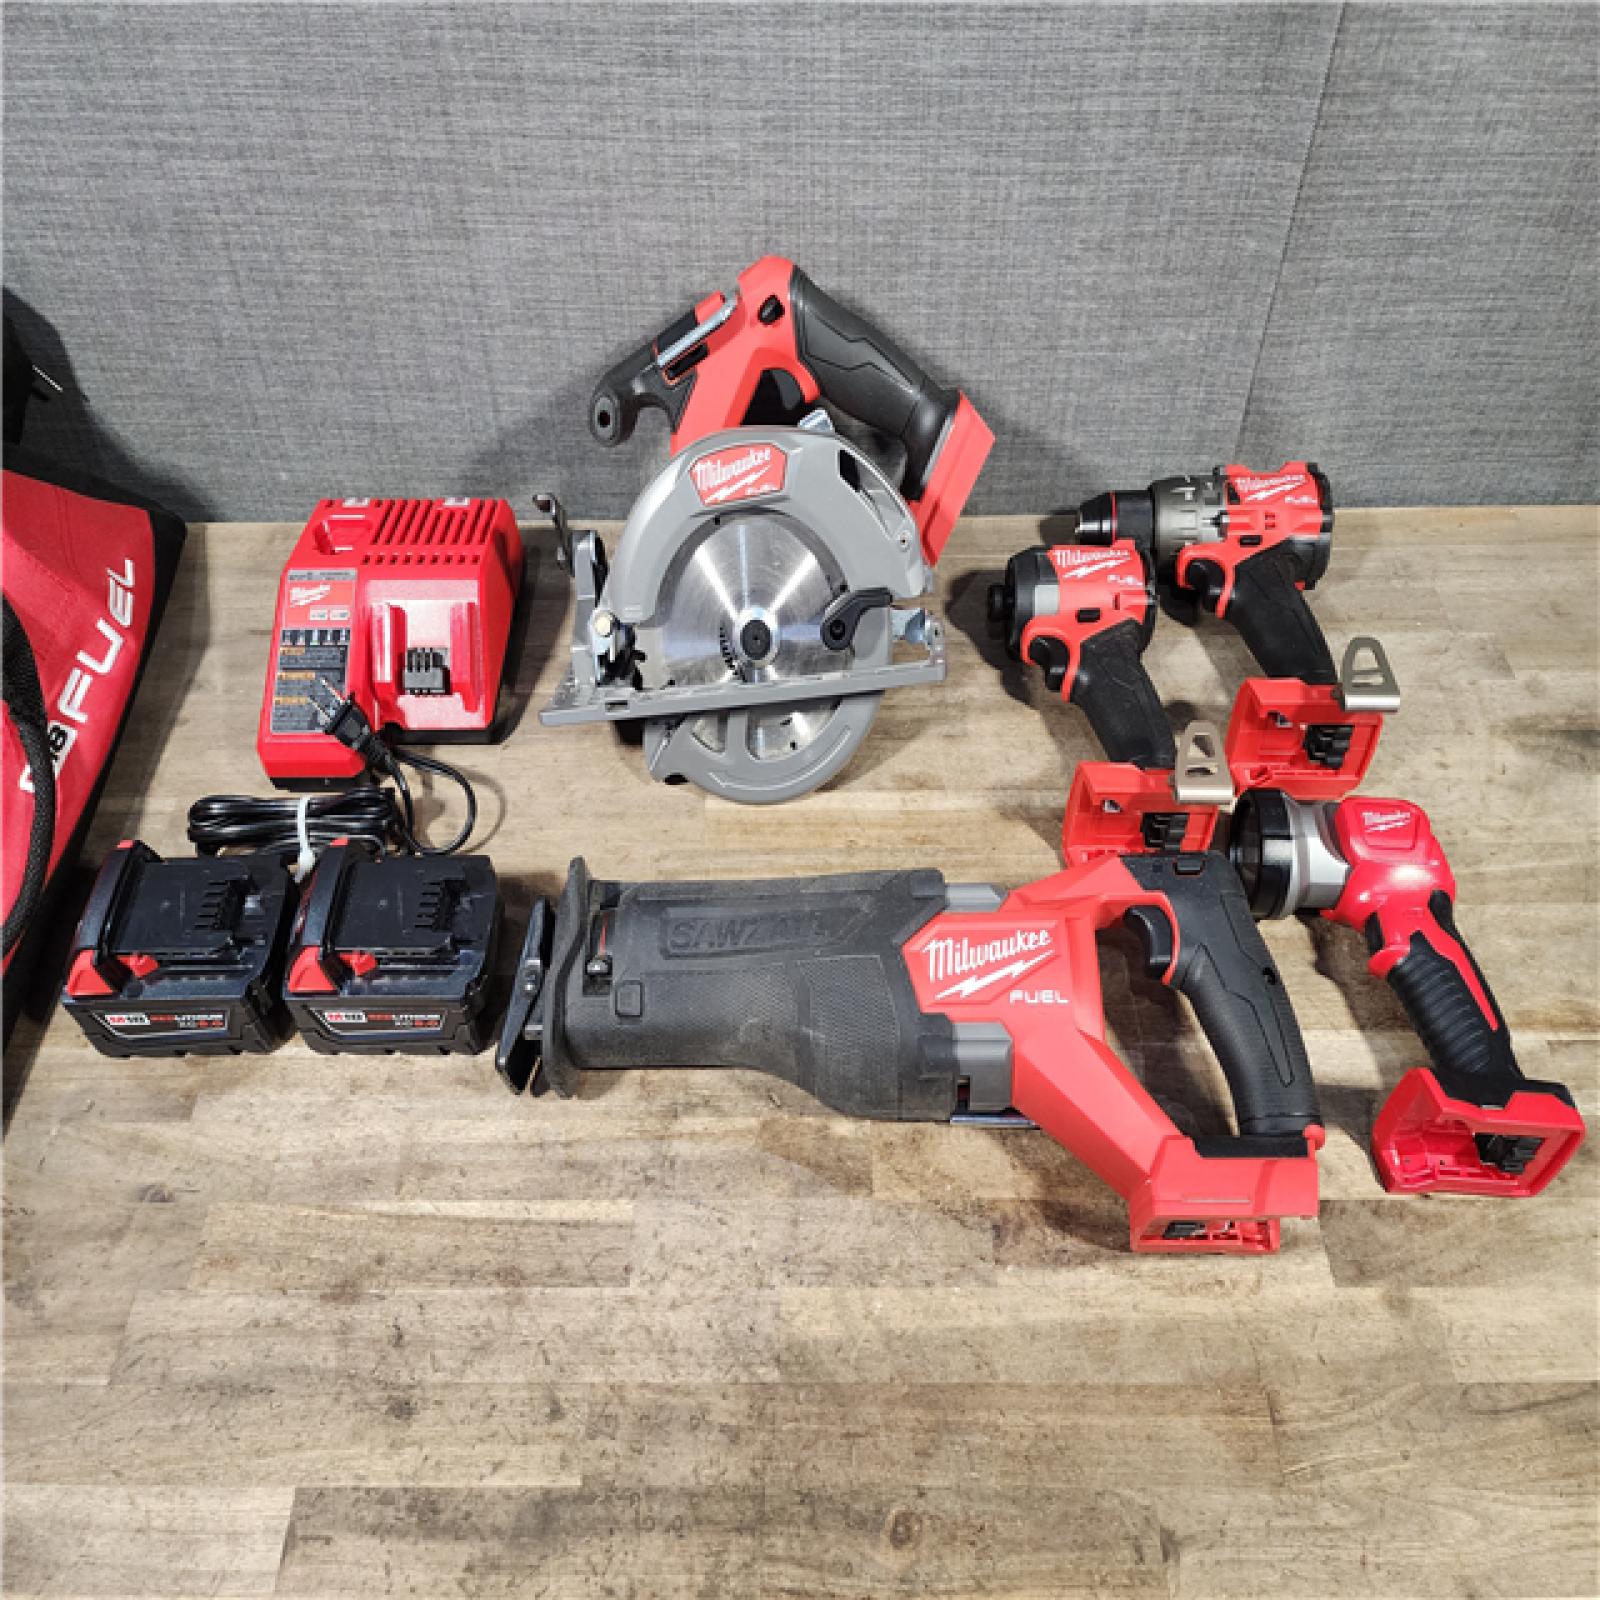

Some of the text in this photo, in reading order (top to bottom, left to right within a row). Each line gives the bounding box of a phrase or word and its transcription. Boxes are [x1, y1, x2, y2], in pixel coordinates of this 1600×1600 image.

[694, 447, 771, 491] Milwaukee
[1052, 549, 1131, 568] Milwaukee
[57, 558, 136, 724] FUEL
[921, 929, 1053, 984] Milwaukee
[1009, 989, 1070, 1004] FUEL
